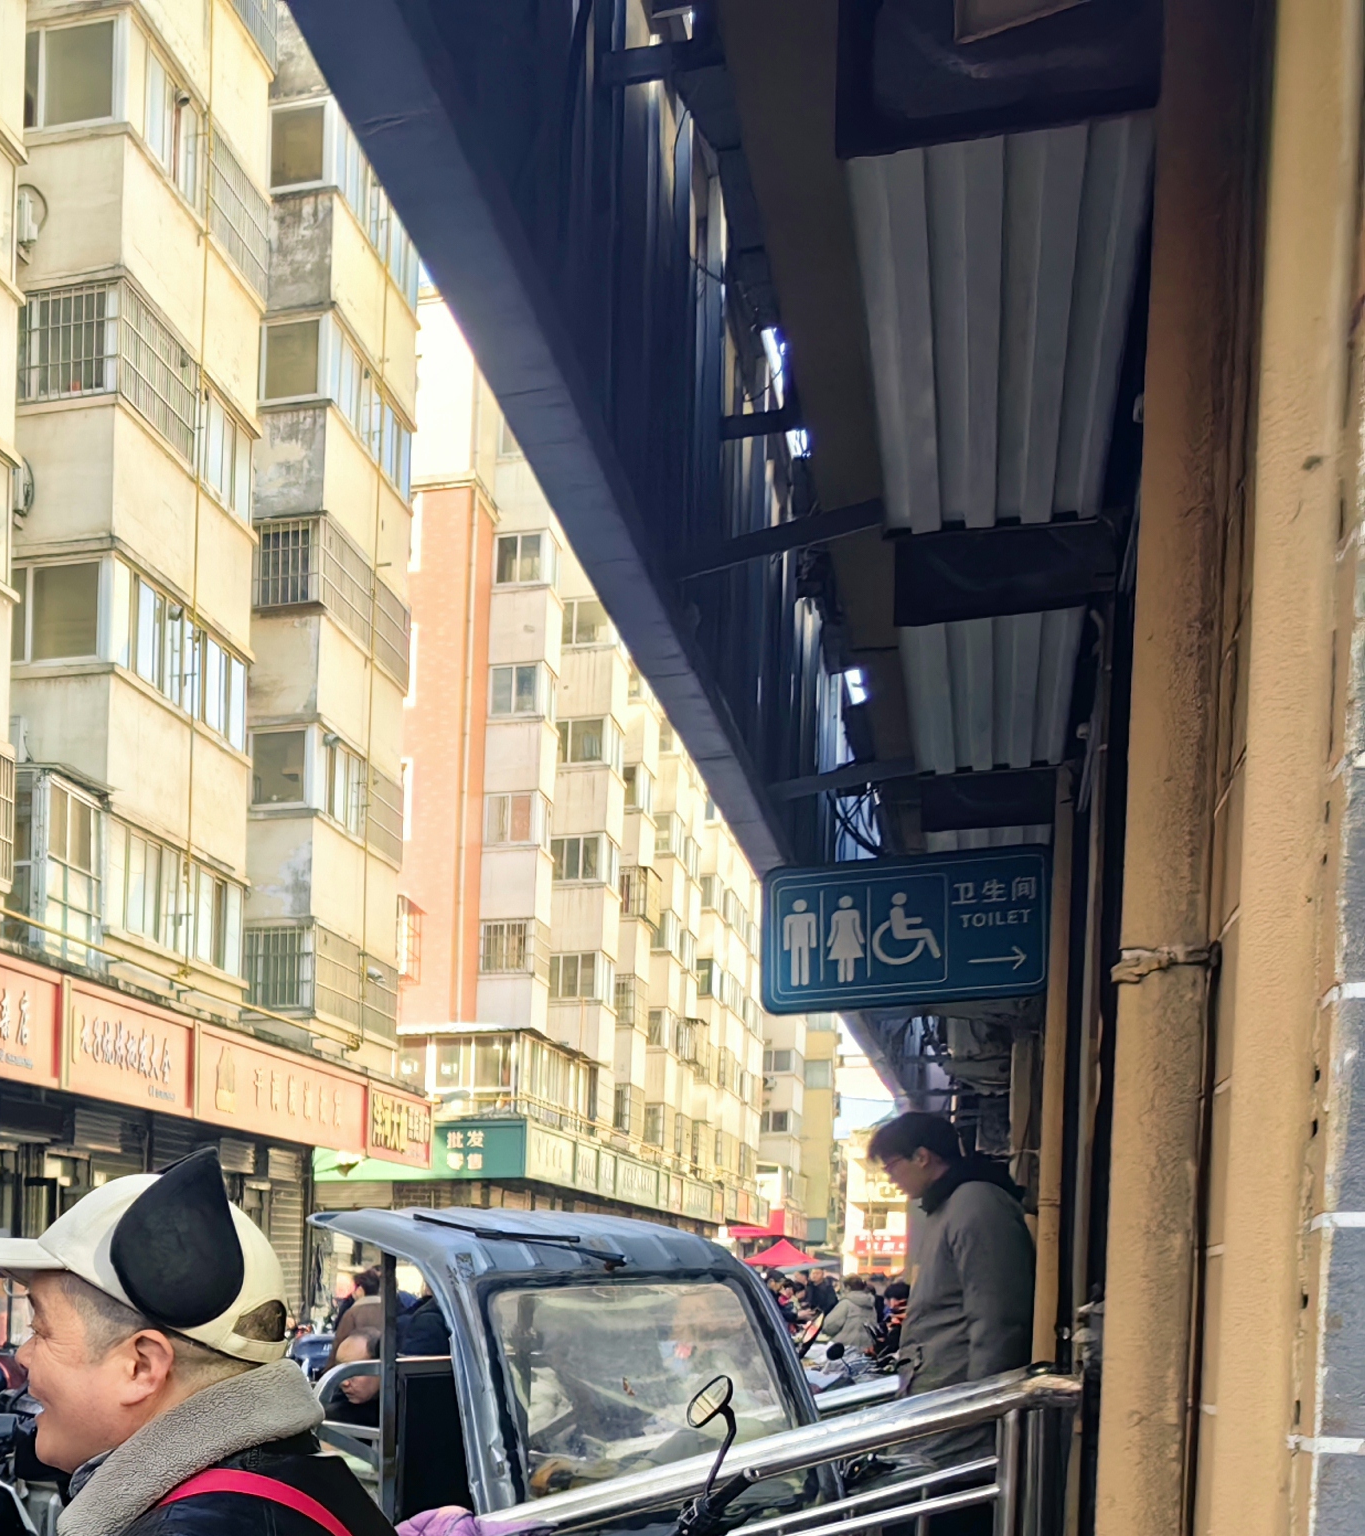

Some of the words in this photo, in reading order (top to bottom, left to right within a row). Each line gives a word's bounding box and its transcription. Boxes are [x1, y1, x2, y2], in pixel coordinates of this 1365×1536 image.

[952, 876, 1036, 905] 卫生间
[959, 909, 1032, 928] TOILET
[446, 1129, 484, 1149] 批发
